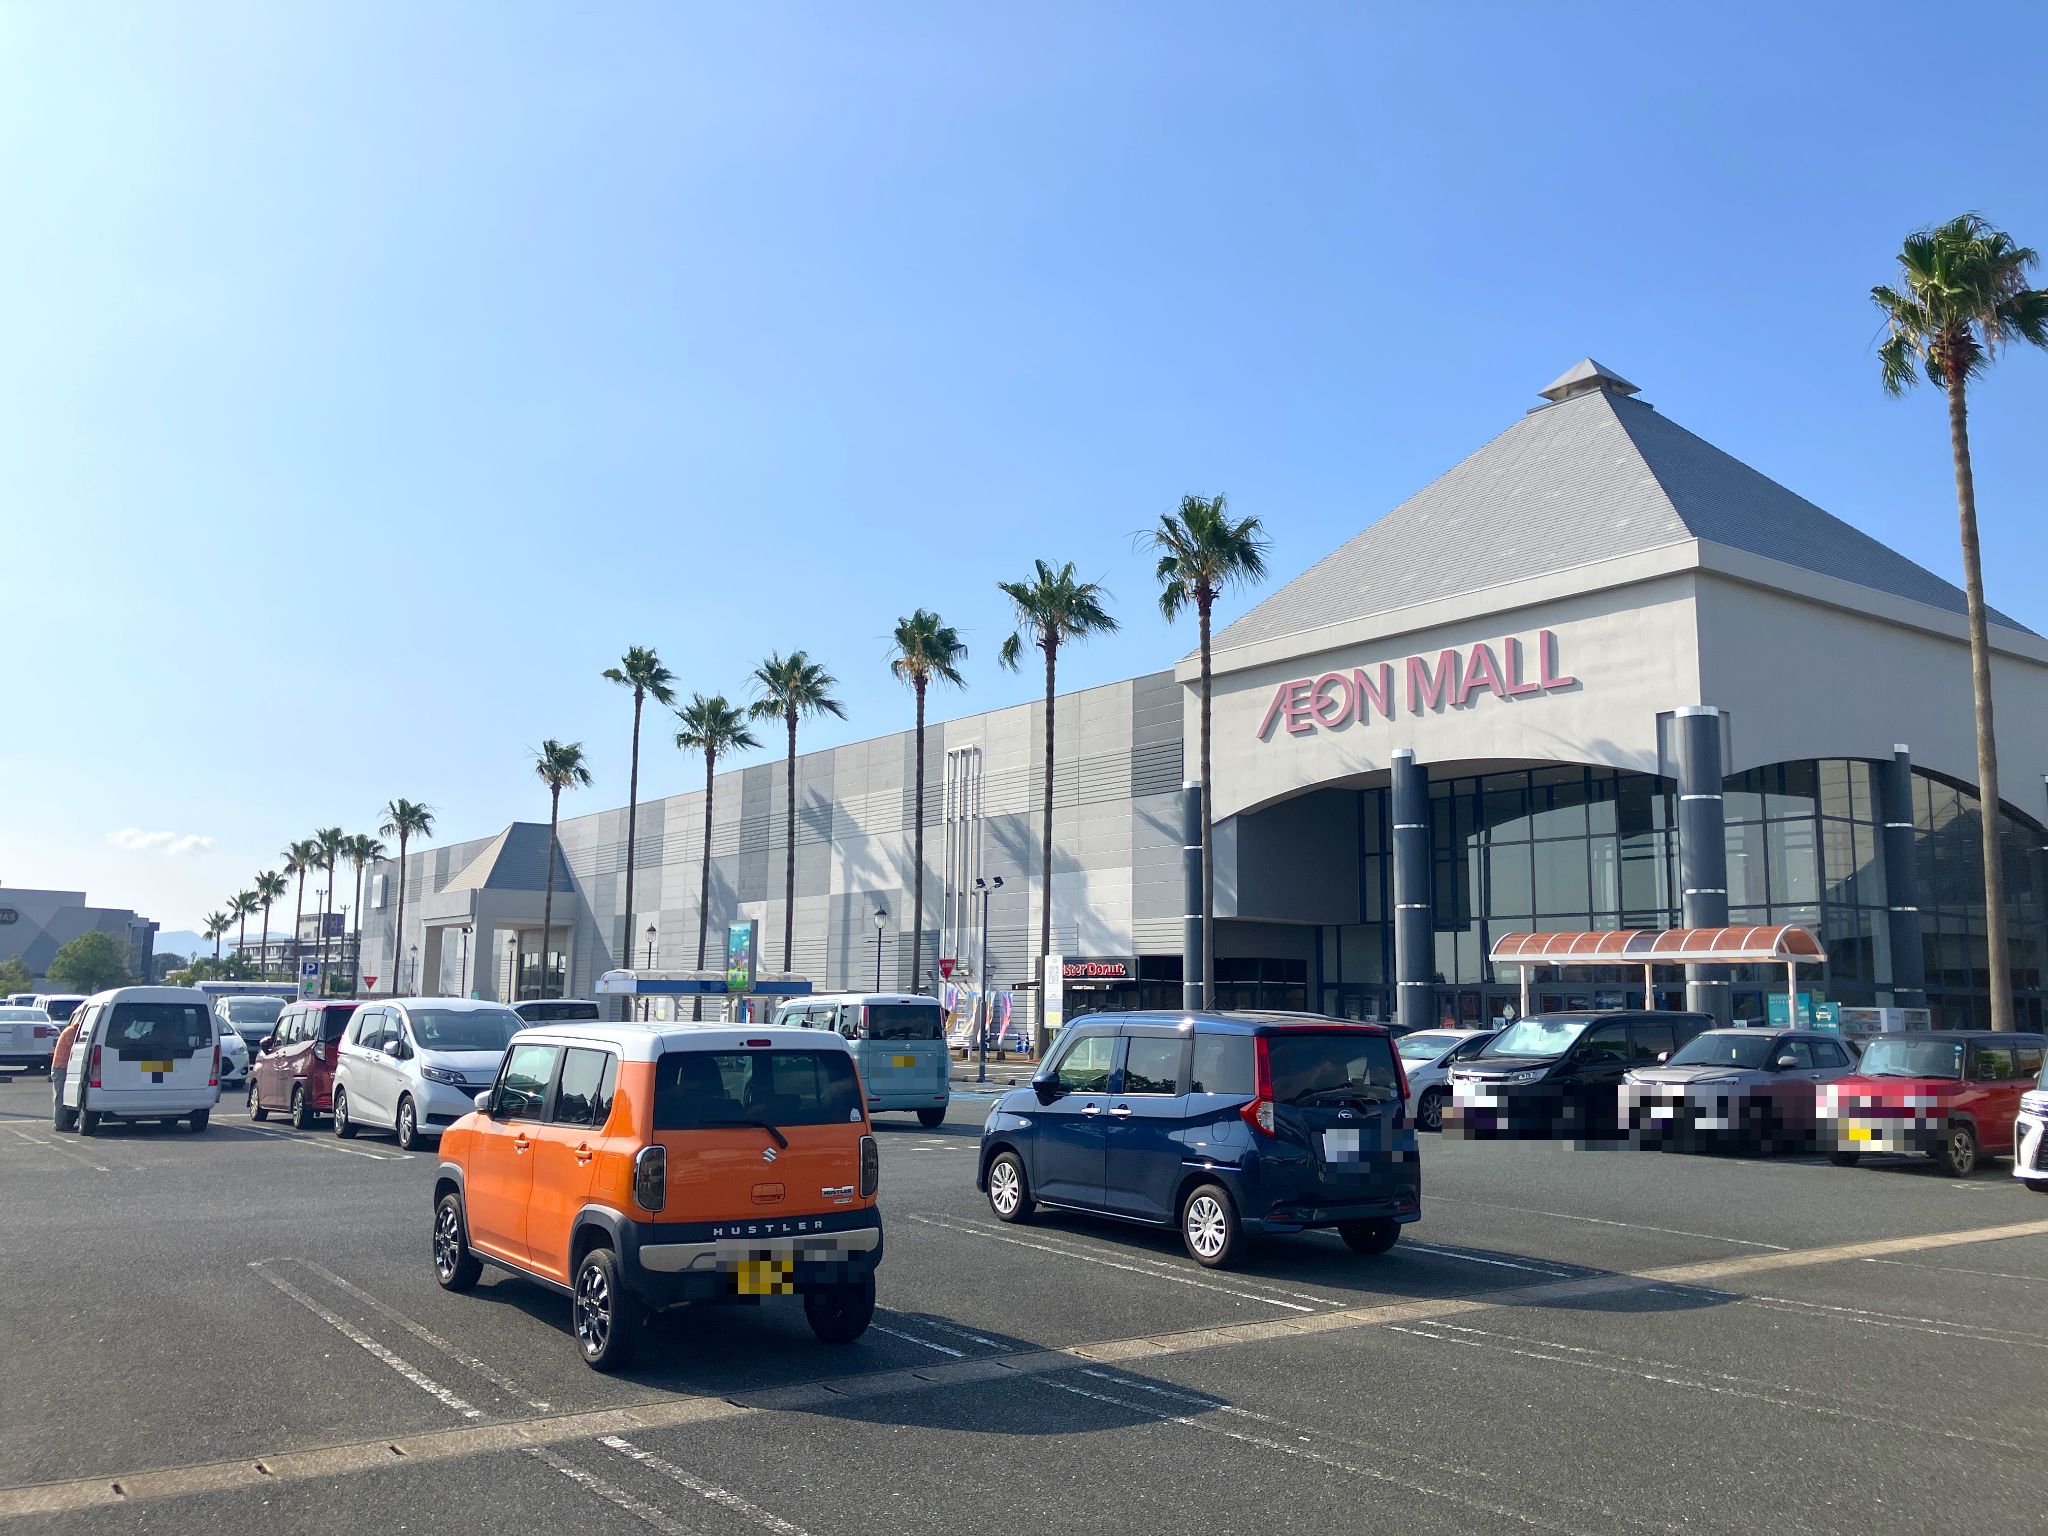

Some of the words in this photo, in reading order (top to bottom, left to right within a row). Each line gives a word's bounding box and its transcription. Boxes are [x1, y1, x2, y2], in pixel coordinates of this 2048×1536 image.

[1406, 630, 1576, 713] MALL
[0, 913, 16, 921] AS
[306, 964, 315, 974] P
[1063, 963, 1087, 977] ster
[1087, 962, 1126, 976] Donut
[823, 1188, 853, 1196] HUSTLER
[713, 1220, 823, 1236] HUSTLER
